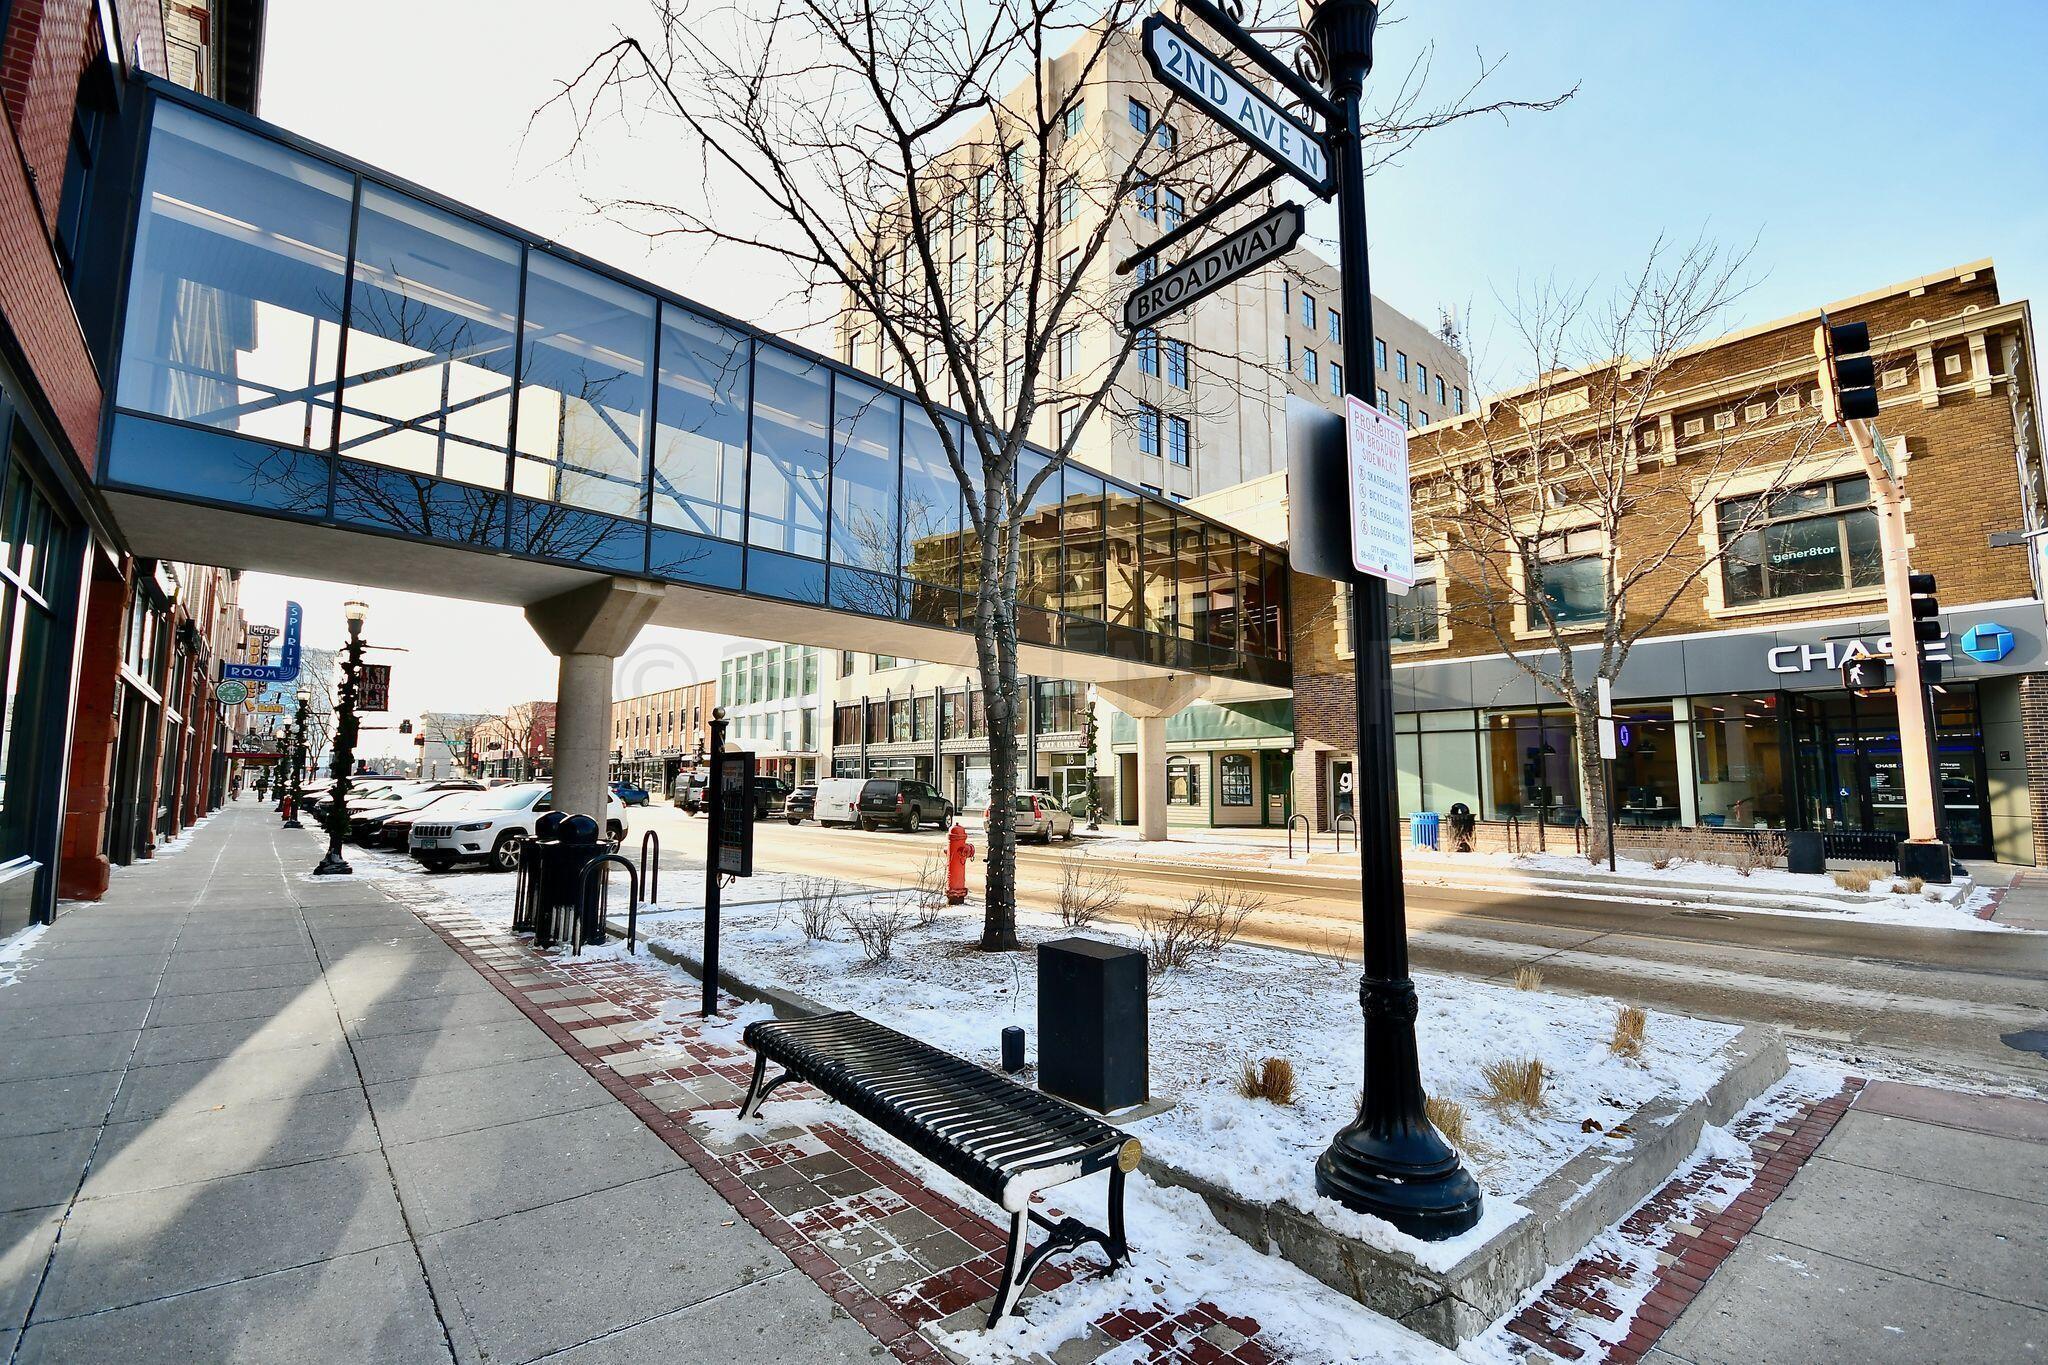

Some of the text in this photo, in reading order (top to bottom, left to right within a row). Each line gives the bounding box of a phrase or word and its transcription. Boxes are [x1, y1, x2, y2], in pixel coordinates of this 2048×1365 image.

[1165, 38, 1319, 177] 2ND AVE N
[1136, 217, 1283, 320] BROADWAY
[1354, 411, 1401, 446] PROHIBITED
[1355, 429, 1401, 462] ON BROADWAY
[1361, 448, 1398, 475] SIDEWALKS
[1367, 471, 1404, 496] SKATEBOARDING
[1368, 489, 1404, 512] BICYCLE RIDING
[1369, 507, 1406, 530] ROLLERBLADING
[1370, 525, 1391, 542] SCOOTER
[1772, 545, 1837, 564] gener8tor
[254, 626, 279, 636] HOTEL
[287, 606, 299, 667] SPIRIT
[231, 667, 276, 678] ROOM
[259, 635, 270, 692] DONALON
[1066, 755, 1075, 765] 118
[1338, 772, 1353, 793] g
